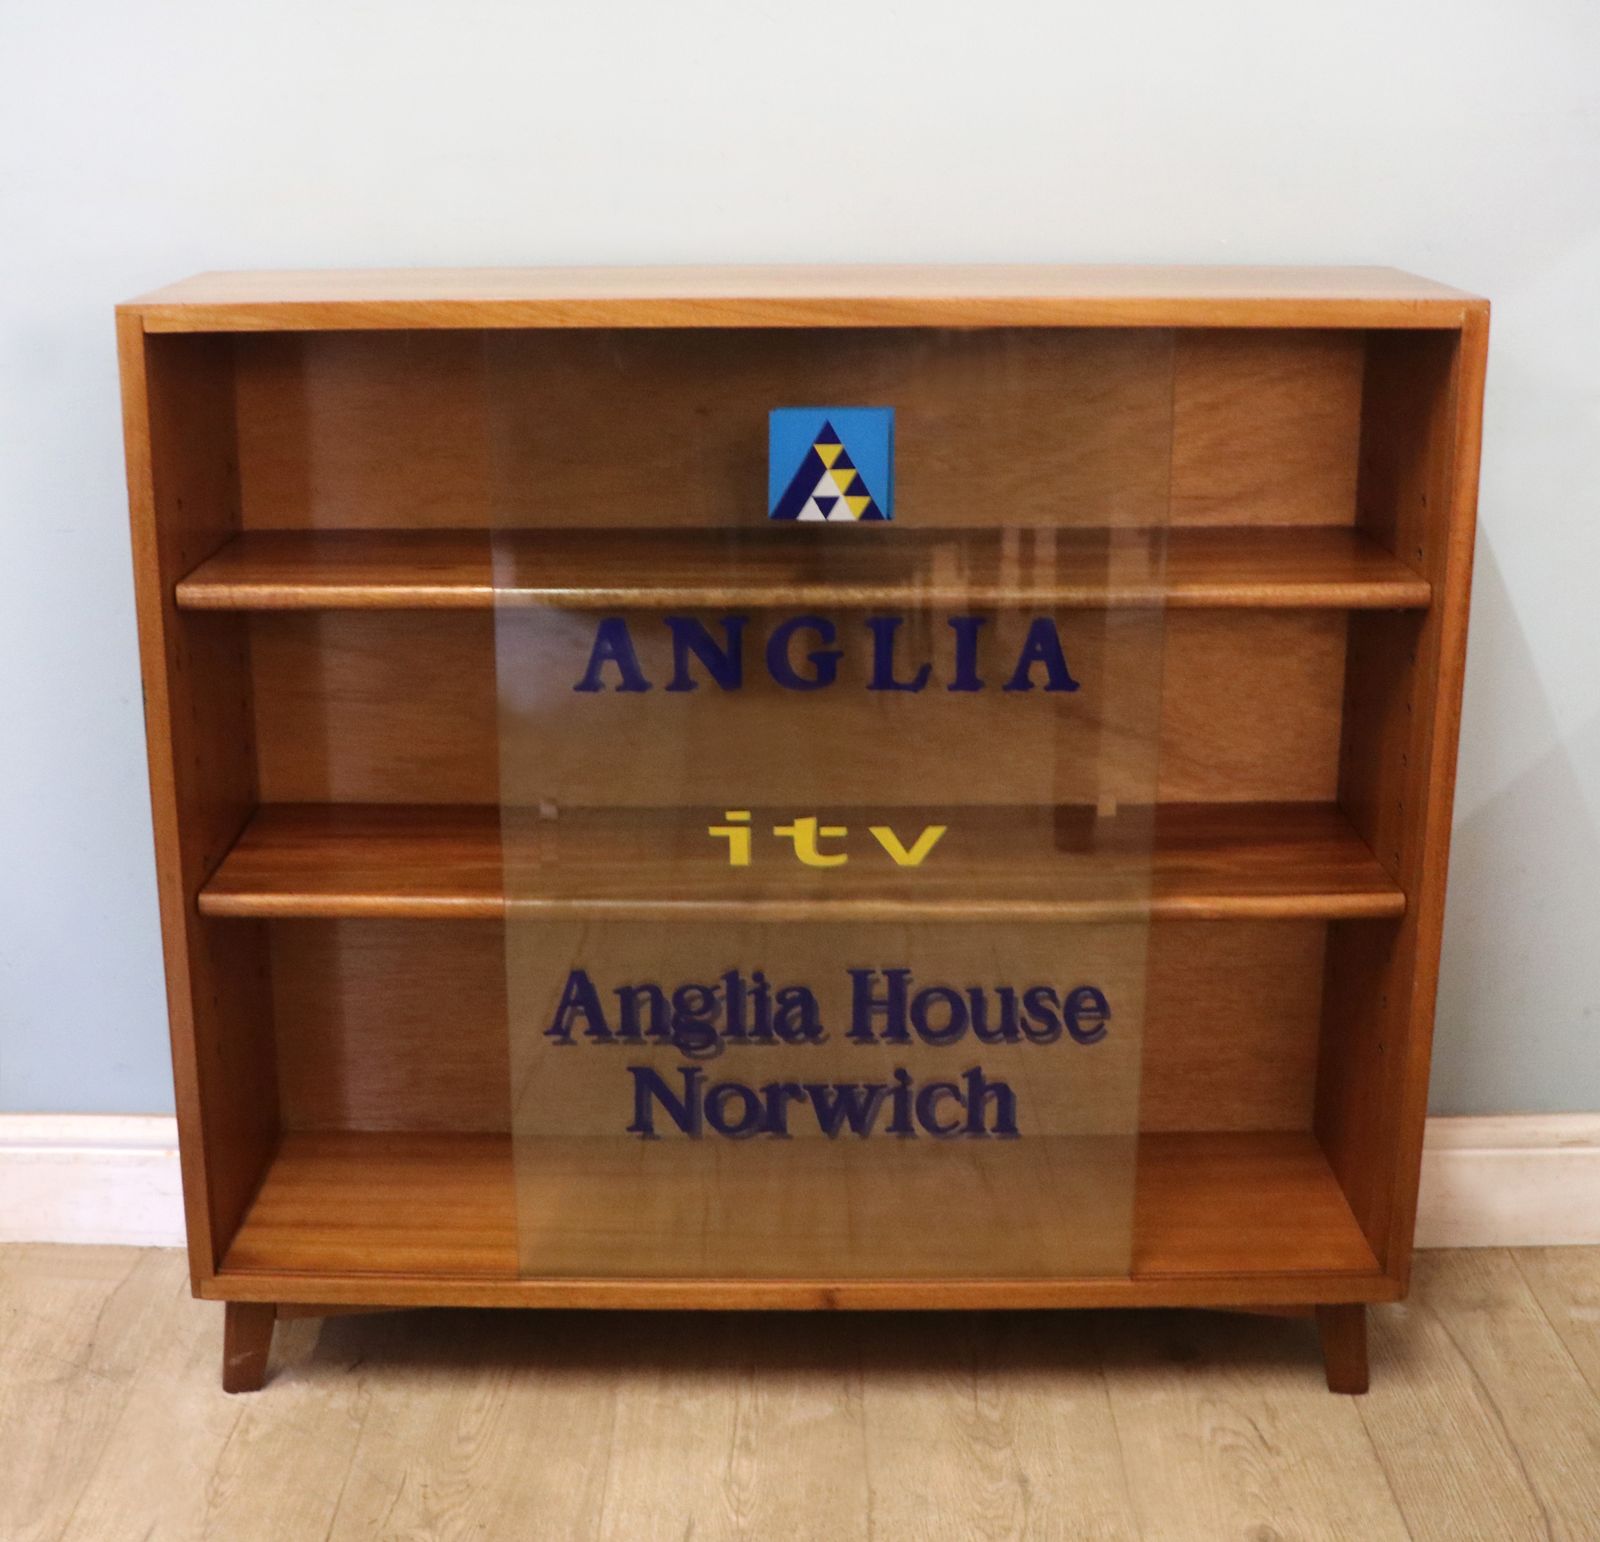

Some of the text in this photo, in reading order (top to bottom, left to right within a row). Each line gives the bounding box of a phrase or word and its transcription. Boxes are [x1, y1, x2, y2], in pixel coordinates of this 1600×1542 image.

[573, 616, 1080, 693] ANGLIA
[708, 811, 948, 866] itv
[543, 967, 1110, 1056] Anglia House
[625, 1065, 1019, 1139] Norwich
